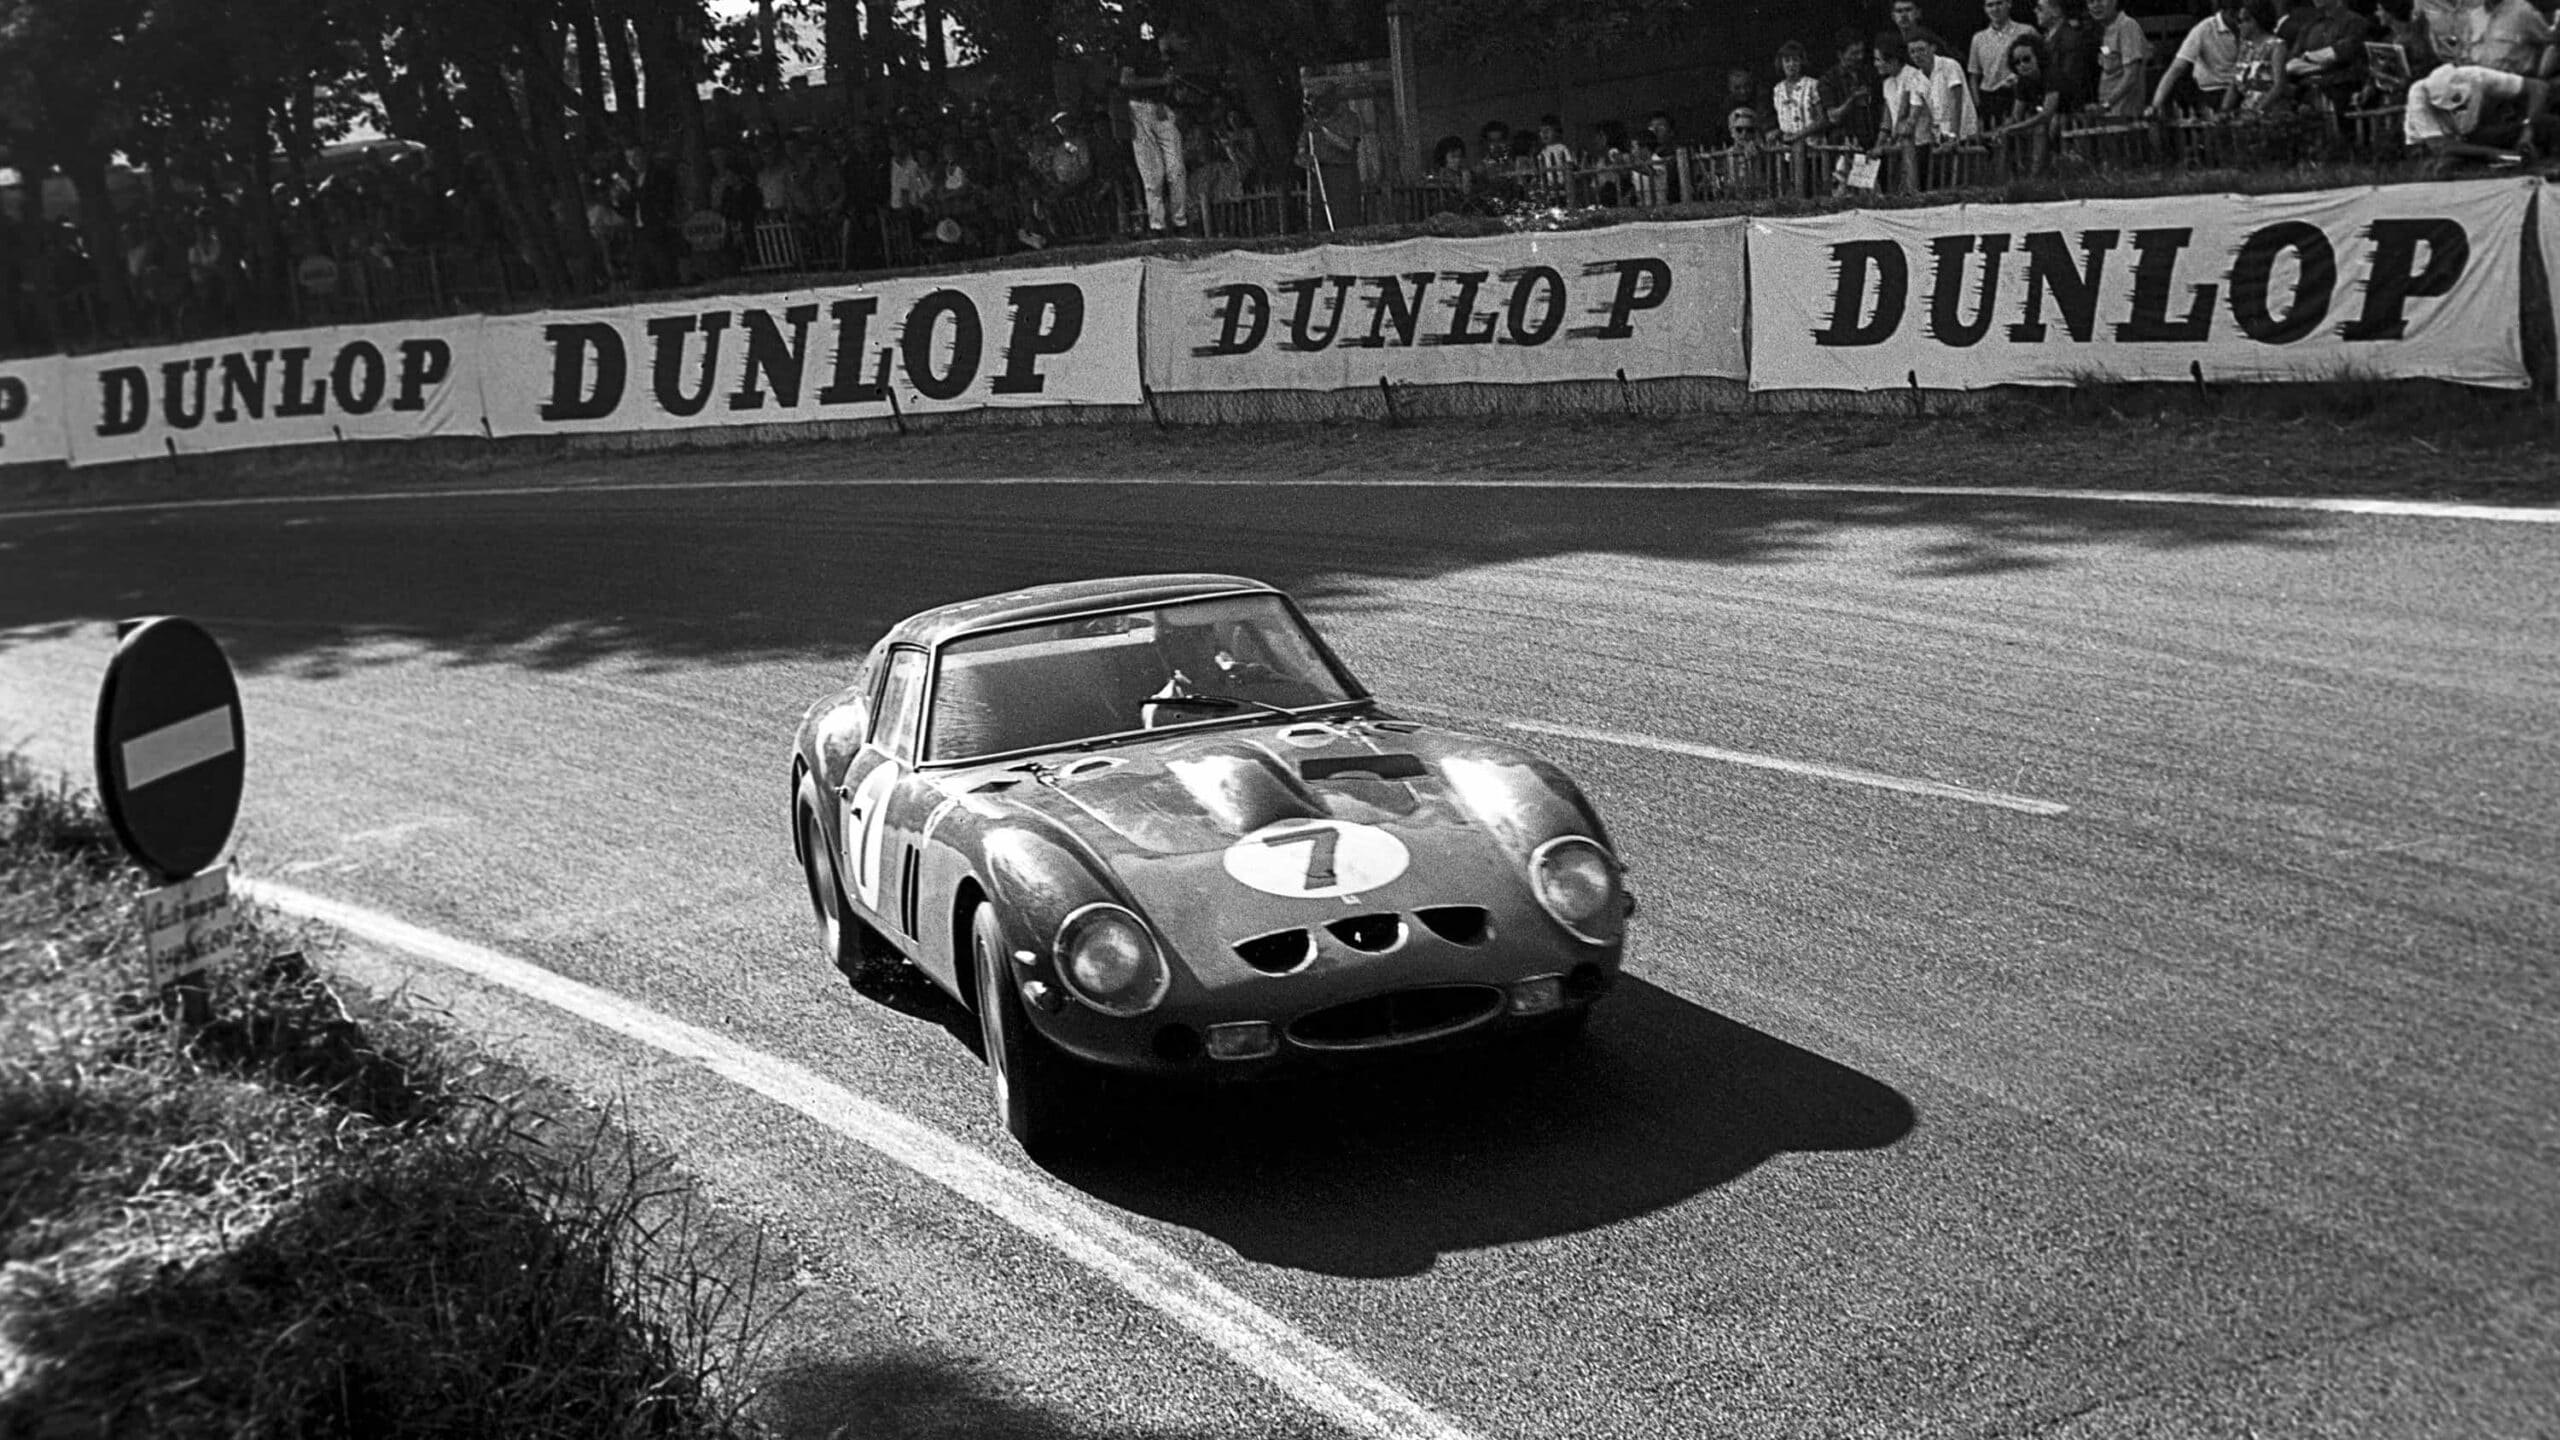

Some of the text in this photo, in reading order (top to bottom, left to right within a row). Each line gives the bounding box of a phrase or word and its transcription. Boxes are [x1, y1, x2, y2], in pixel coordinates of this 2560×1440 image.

[1191, 257, 1672, 358] DUNLOP
[1809, 218, 2470, 348] DUNLOP
[96, 338, 451, 438] DUNLOP
[539, 282, 1085, 422] DUNLOP
[1262, 826, 1340, 890] 7
